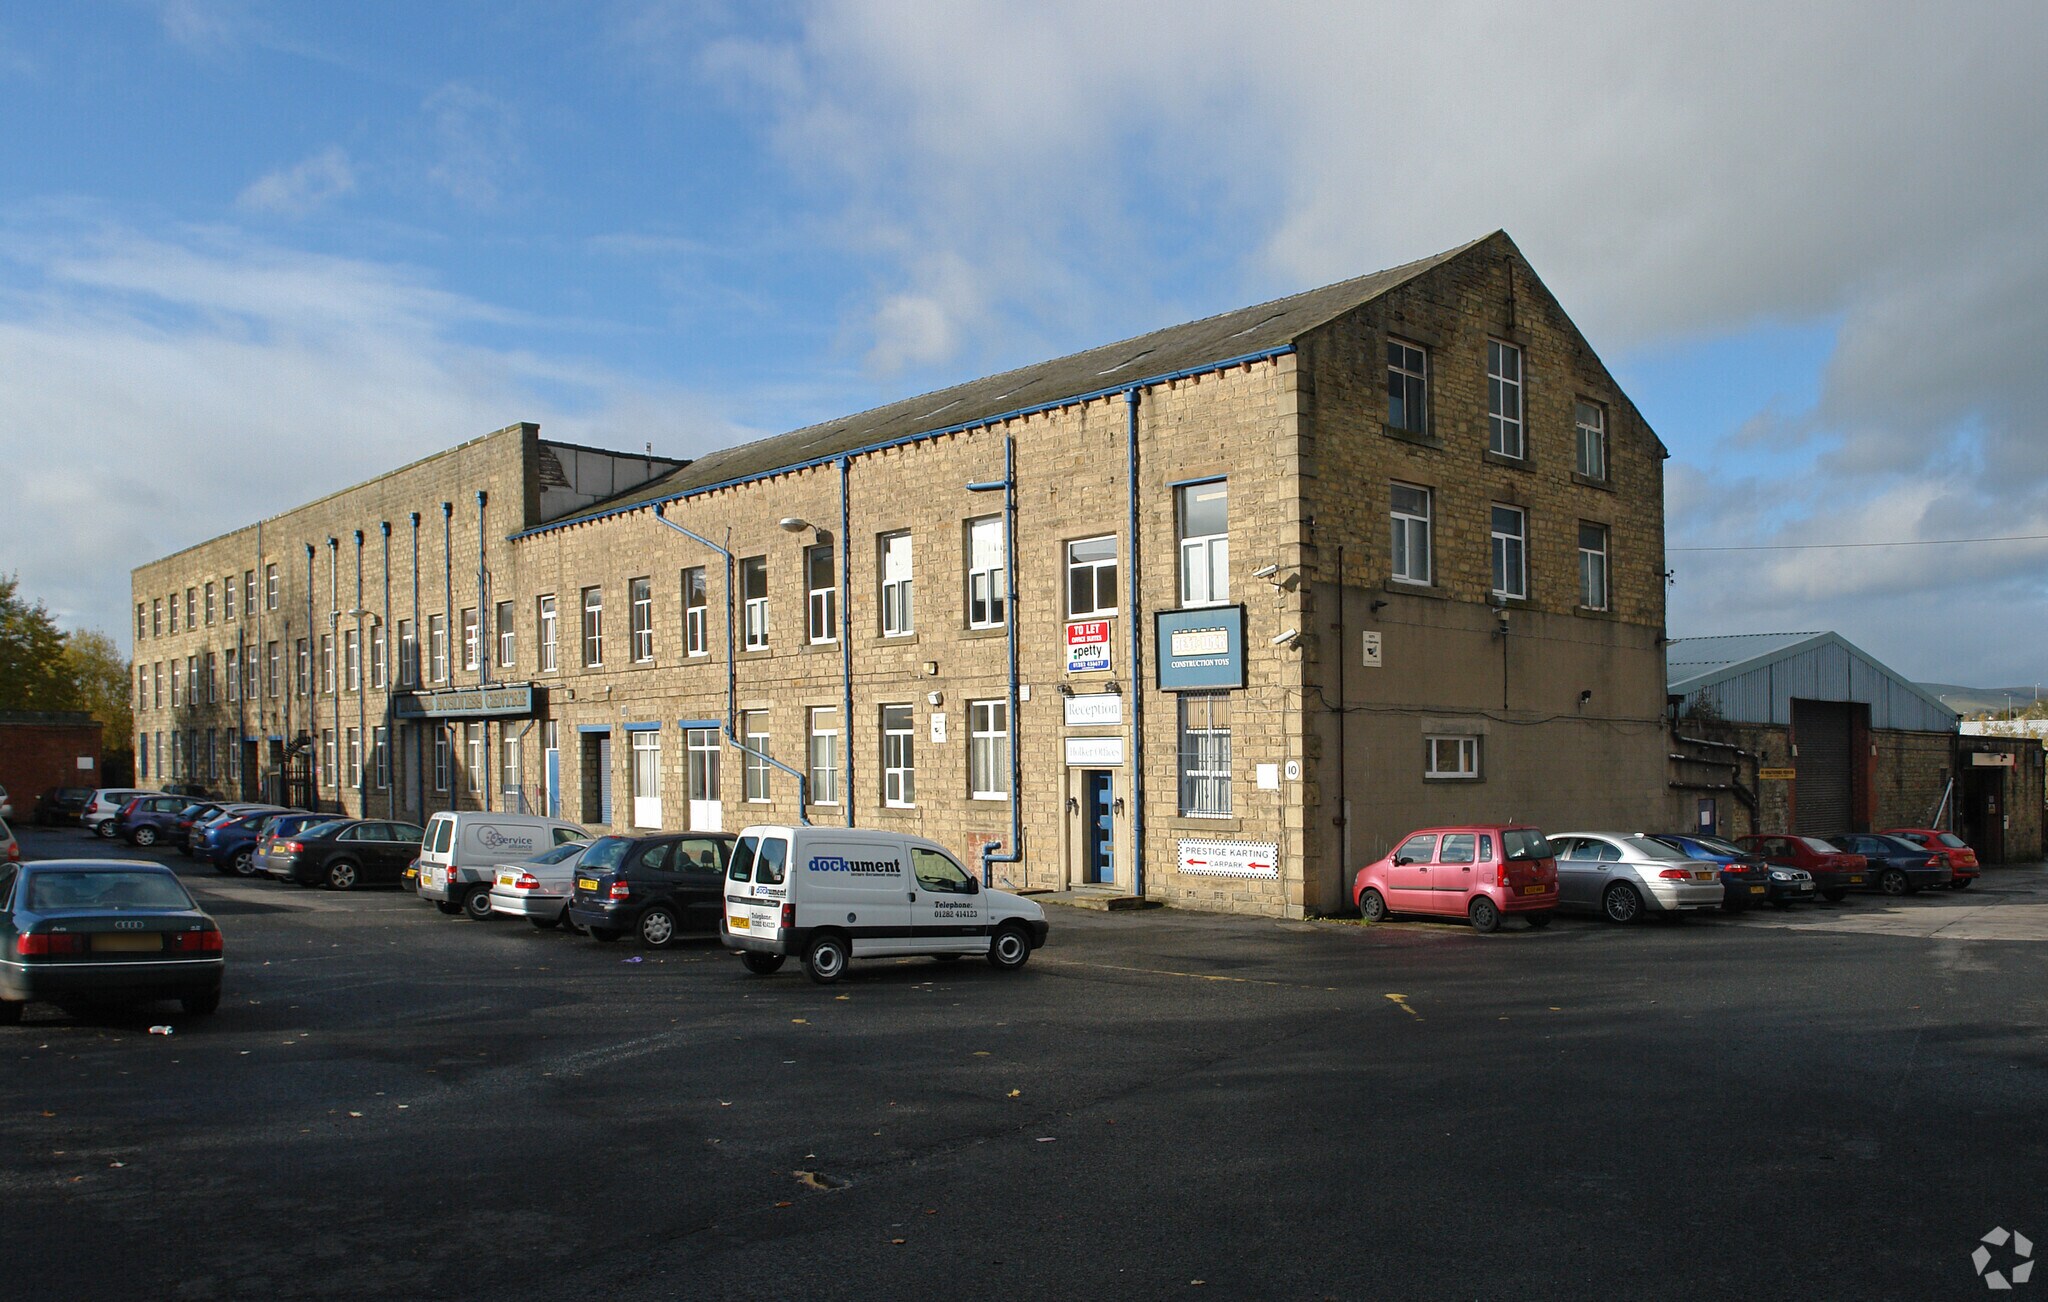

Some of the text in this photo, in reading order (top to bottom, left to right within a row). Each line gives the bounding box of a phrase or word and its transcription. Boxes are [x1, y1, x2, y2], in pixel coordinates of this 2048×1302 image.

[1074, 624, 1100, 635] TO LET
[1078, 645, 1102, 659] petty
[1171, 658, 1230, 668] CONSTRUCTION TOYS
[485, 690, 527, 709] CENTRE
[1069, 702, 1118, 718] Reception
[1094, 746, 1120, 757] Offices
[1288, 765, 1297, 775] 10
[498, 836, 533, 844] service
[1185, 847, 1269, 859] PRESTIGE KARTING
[808, 856, 901, 873] dockument
[1208, 860, 1244, 868] CARPARK
[934, 901, 973, 910] Telephone:
